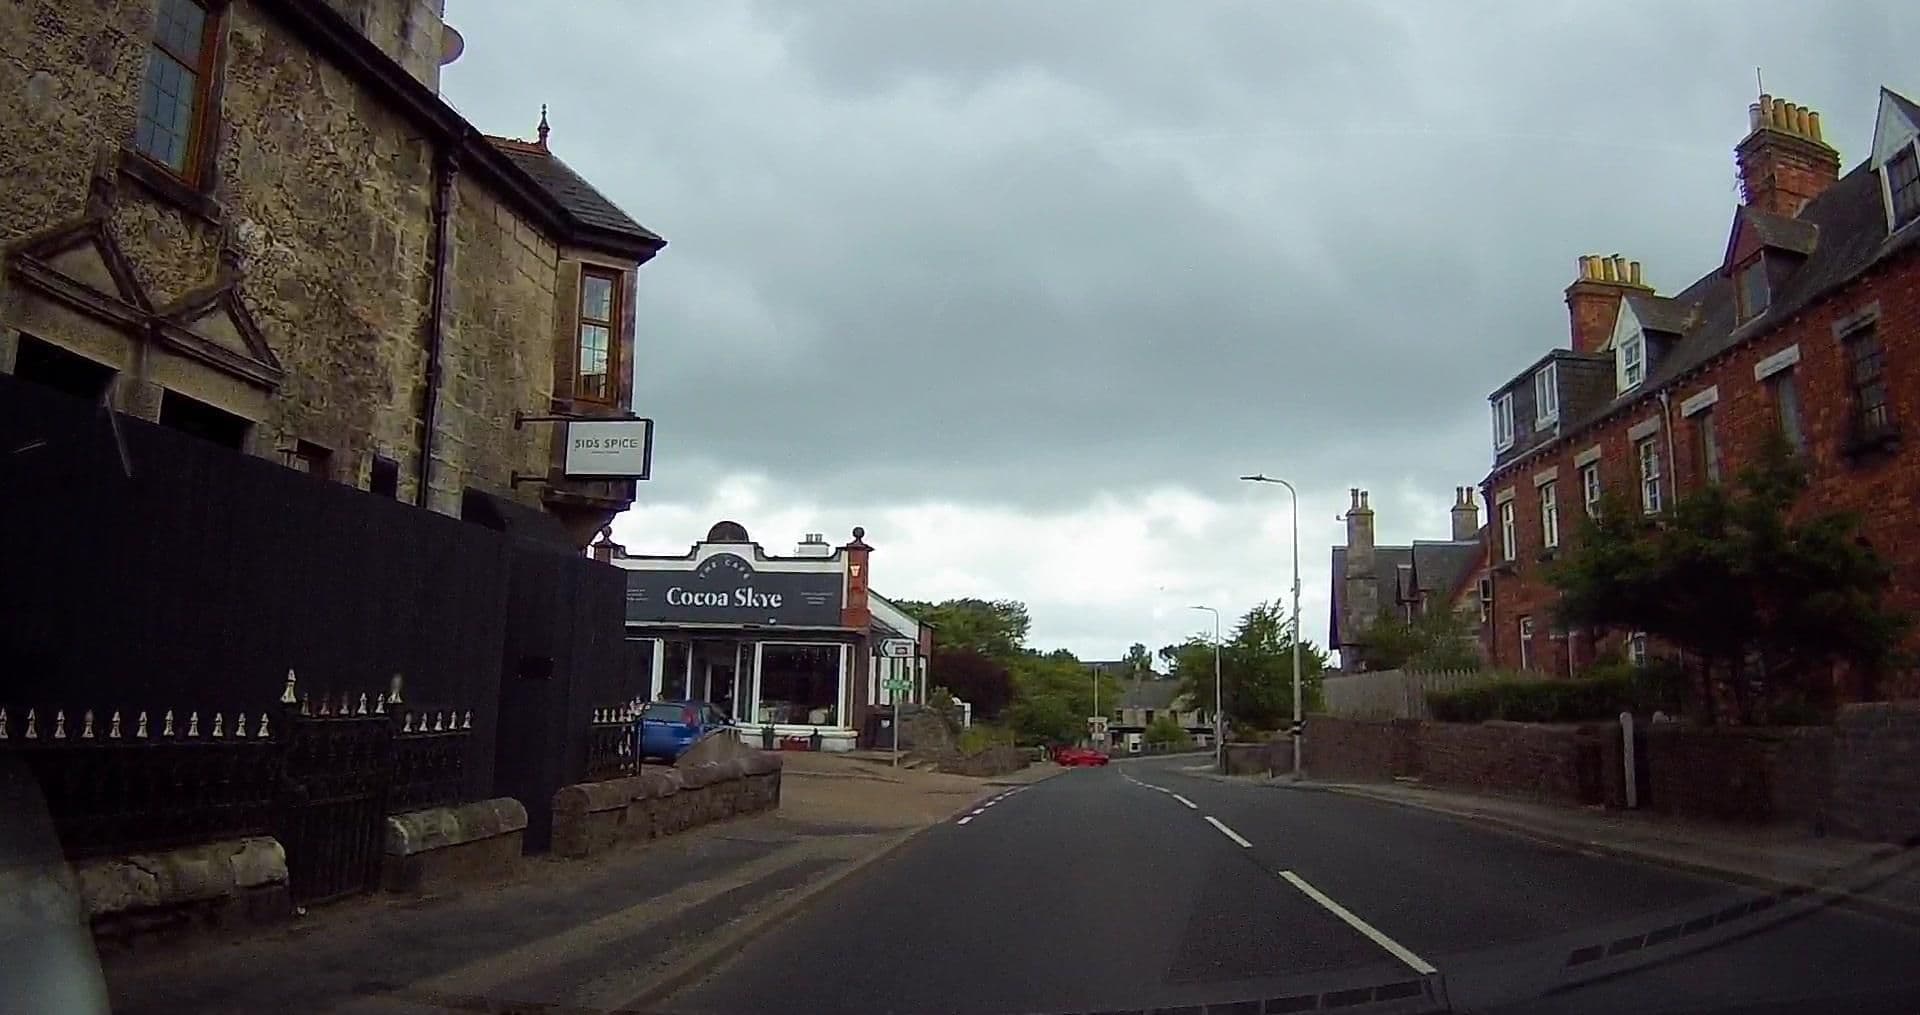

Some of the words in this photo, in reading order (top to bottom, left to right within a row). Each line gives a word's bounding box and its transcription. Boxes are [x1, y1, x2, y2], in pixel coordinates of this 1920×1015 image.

[603, 438, 639, 449] SPICE
[666, 586, 729, 606] Cocoa
[734, 586, 783, 608] Skye
